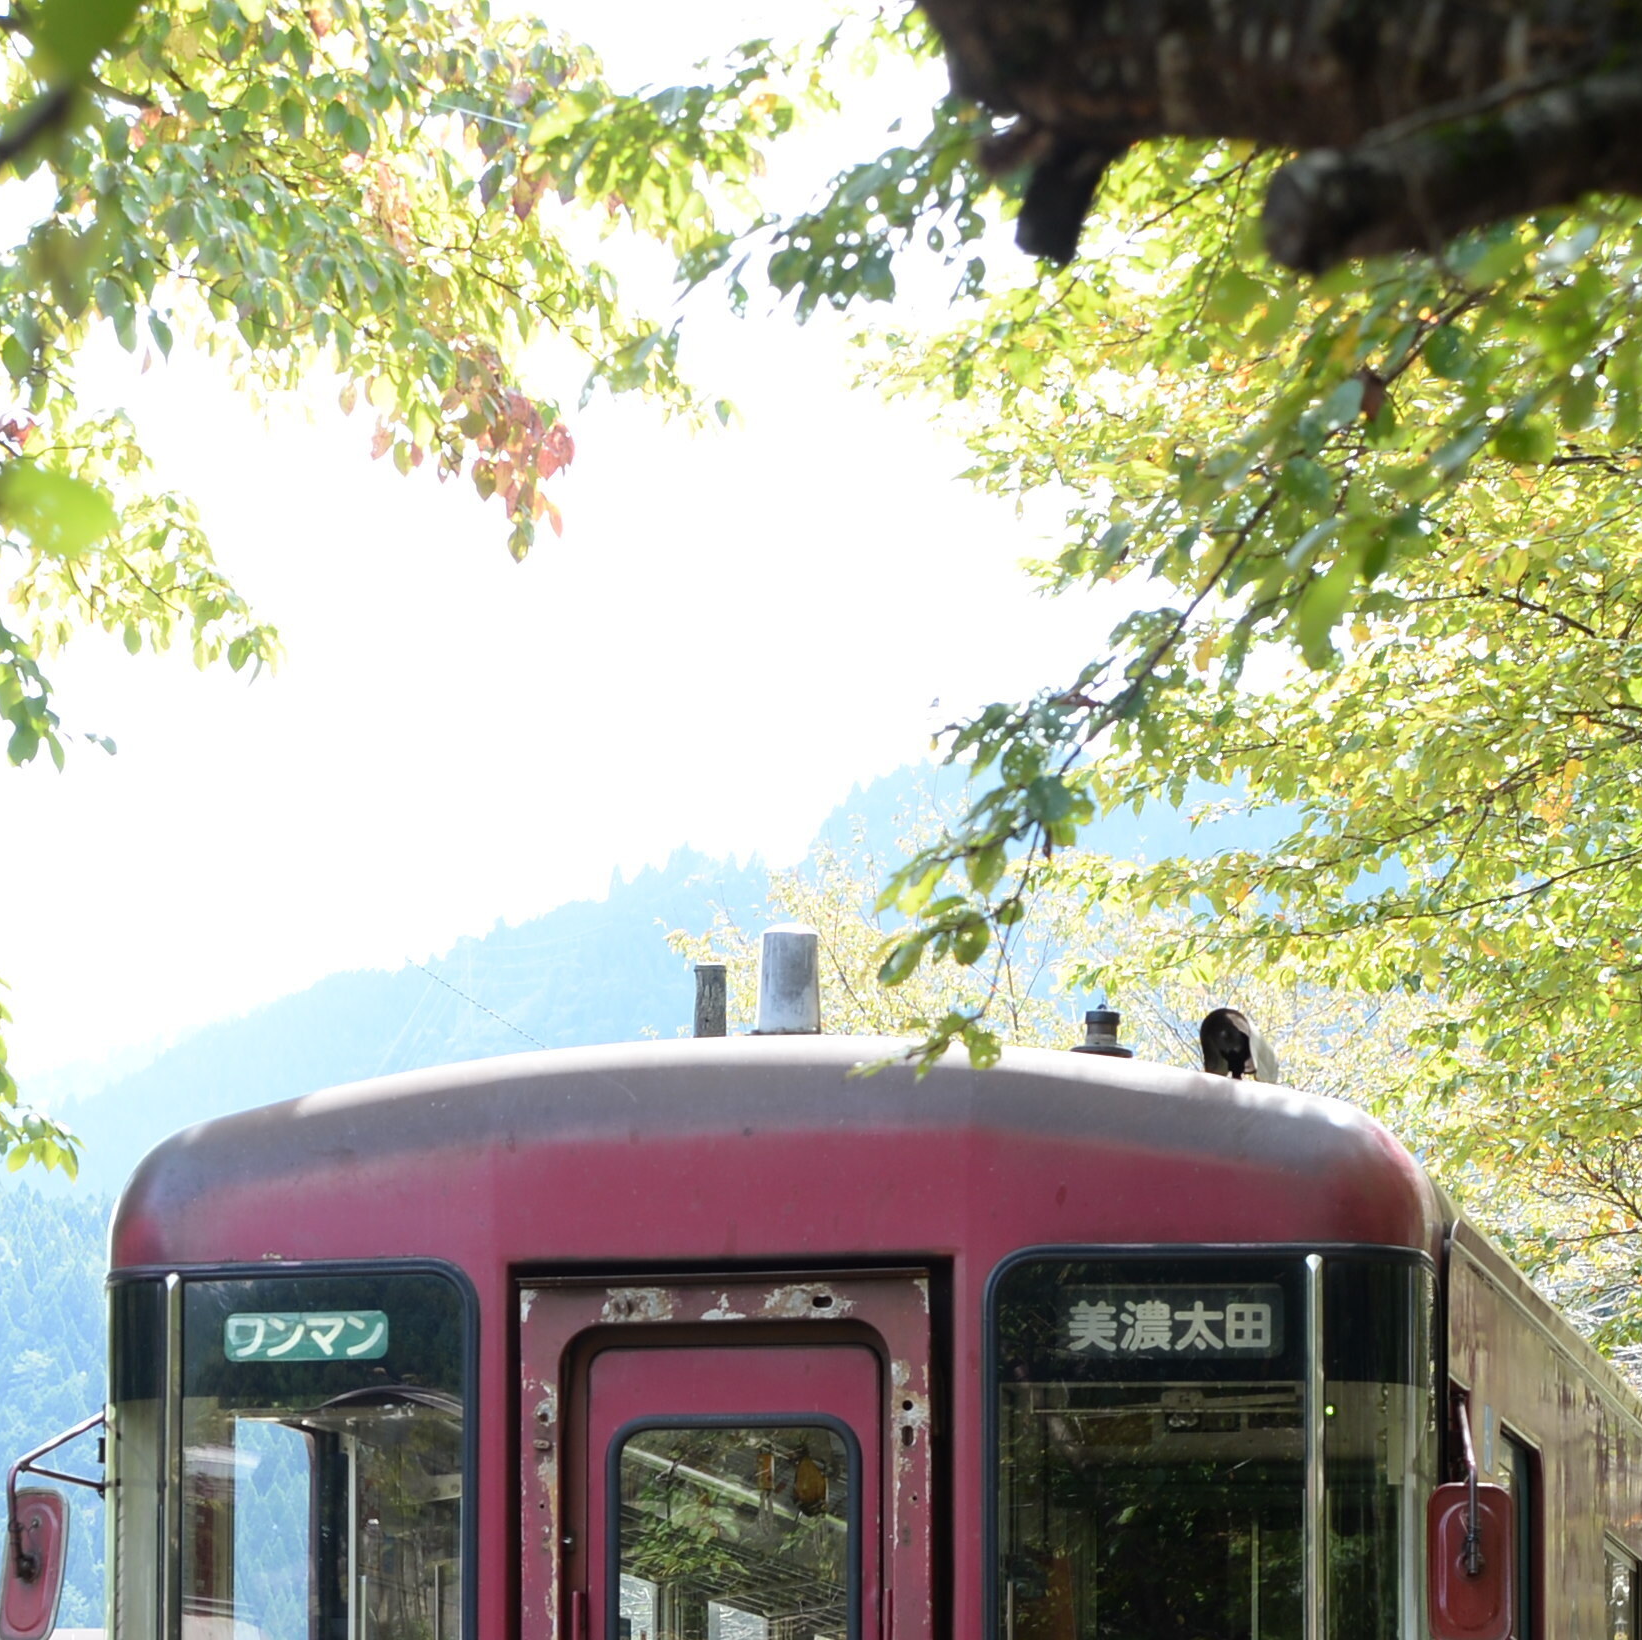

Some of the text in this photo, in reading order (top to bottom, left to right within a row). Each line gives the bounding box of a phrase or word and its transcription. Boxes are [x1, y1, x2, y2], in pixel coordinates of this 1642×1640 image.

[226, 1316, 384, 1357] ワンマン
[1068, 1300, 1272, 1351] 美濃太田
